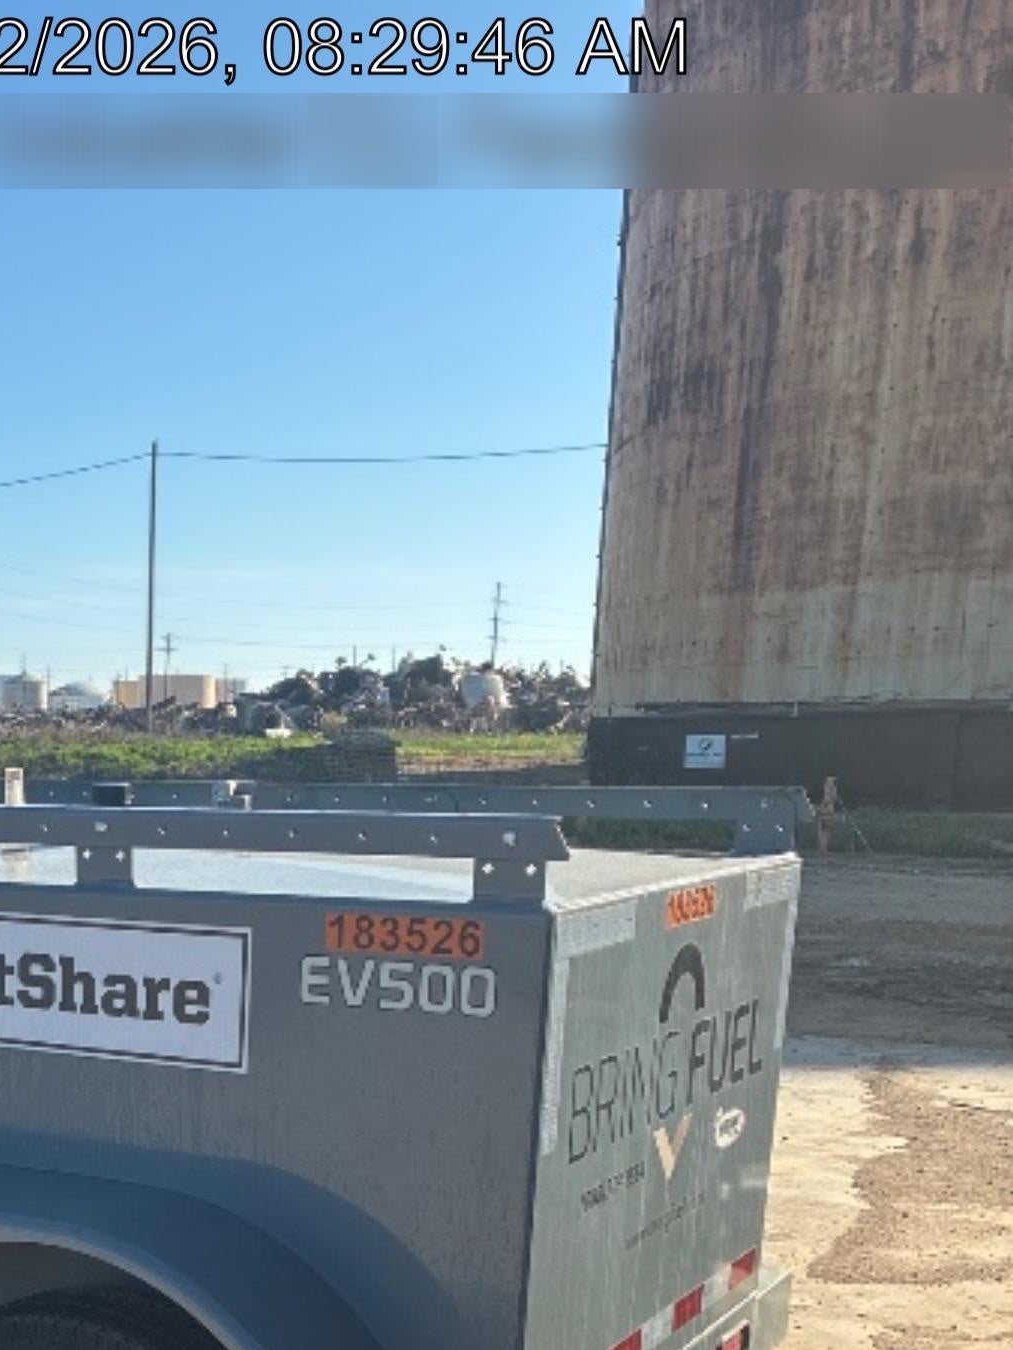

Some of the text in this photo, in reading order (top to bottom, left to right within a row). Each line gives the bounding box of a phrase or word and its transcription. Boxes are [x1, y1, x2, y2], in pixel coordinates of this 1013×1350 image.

[328, 914, 481, 958] 183526
[300, 956, 496, 1018] EV500
[568, 999, 763, 1164] BRING FUEL
